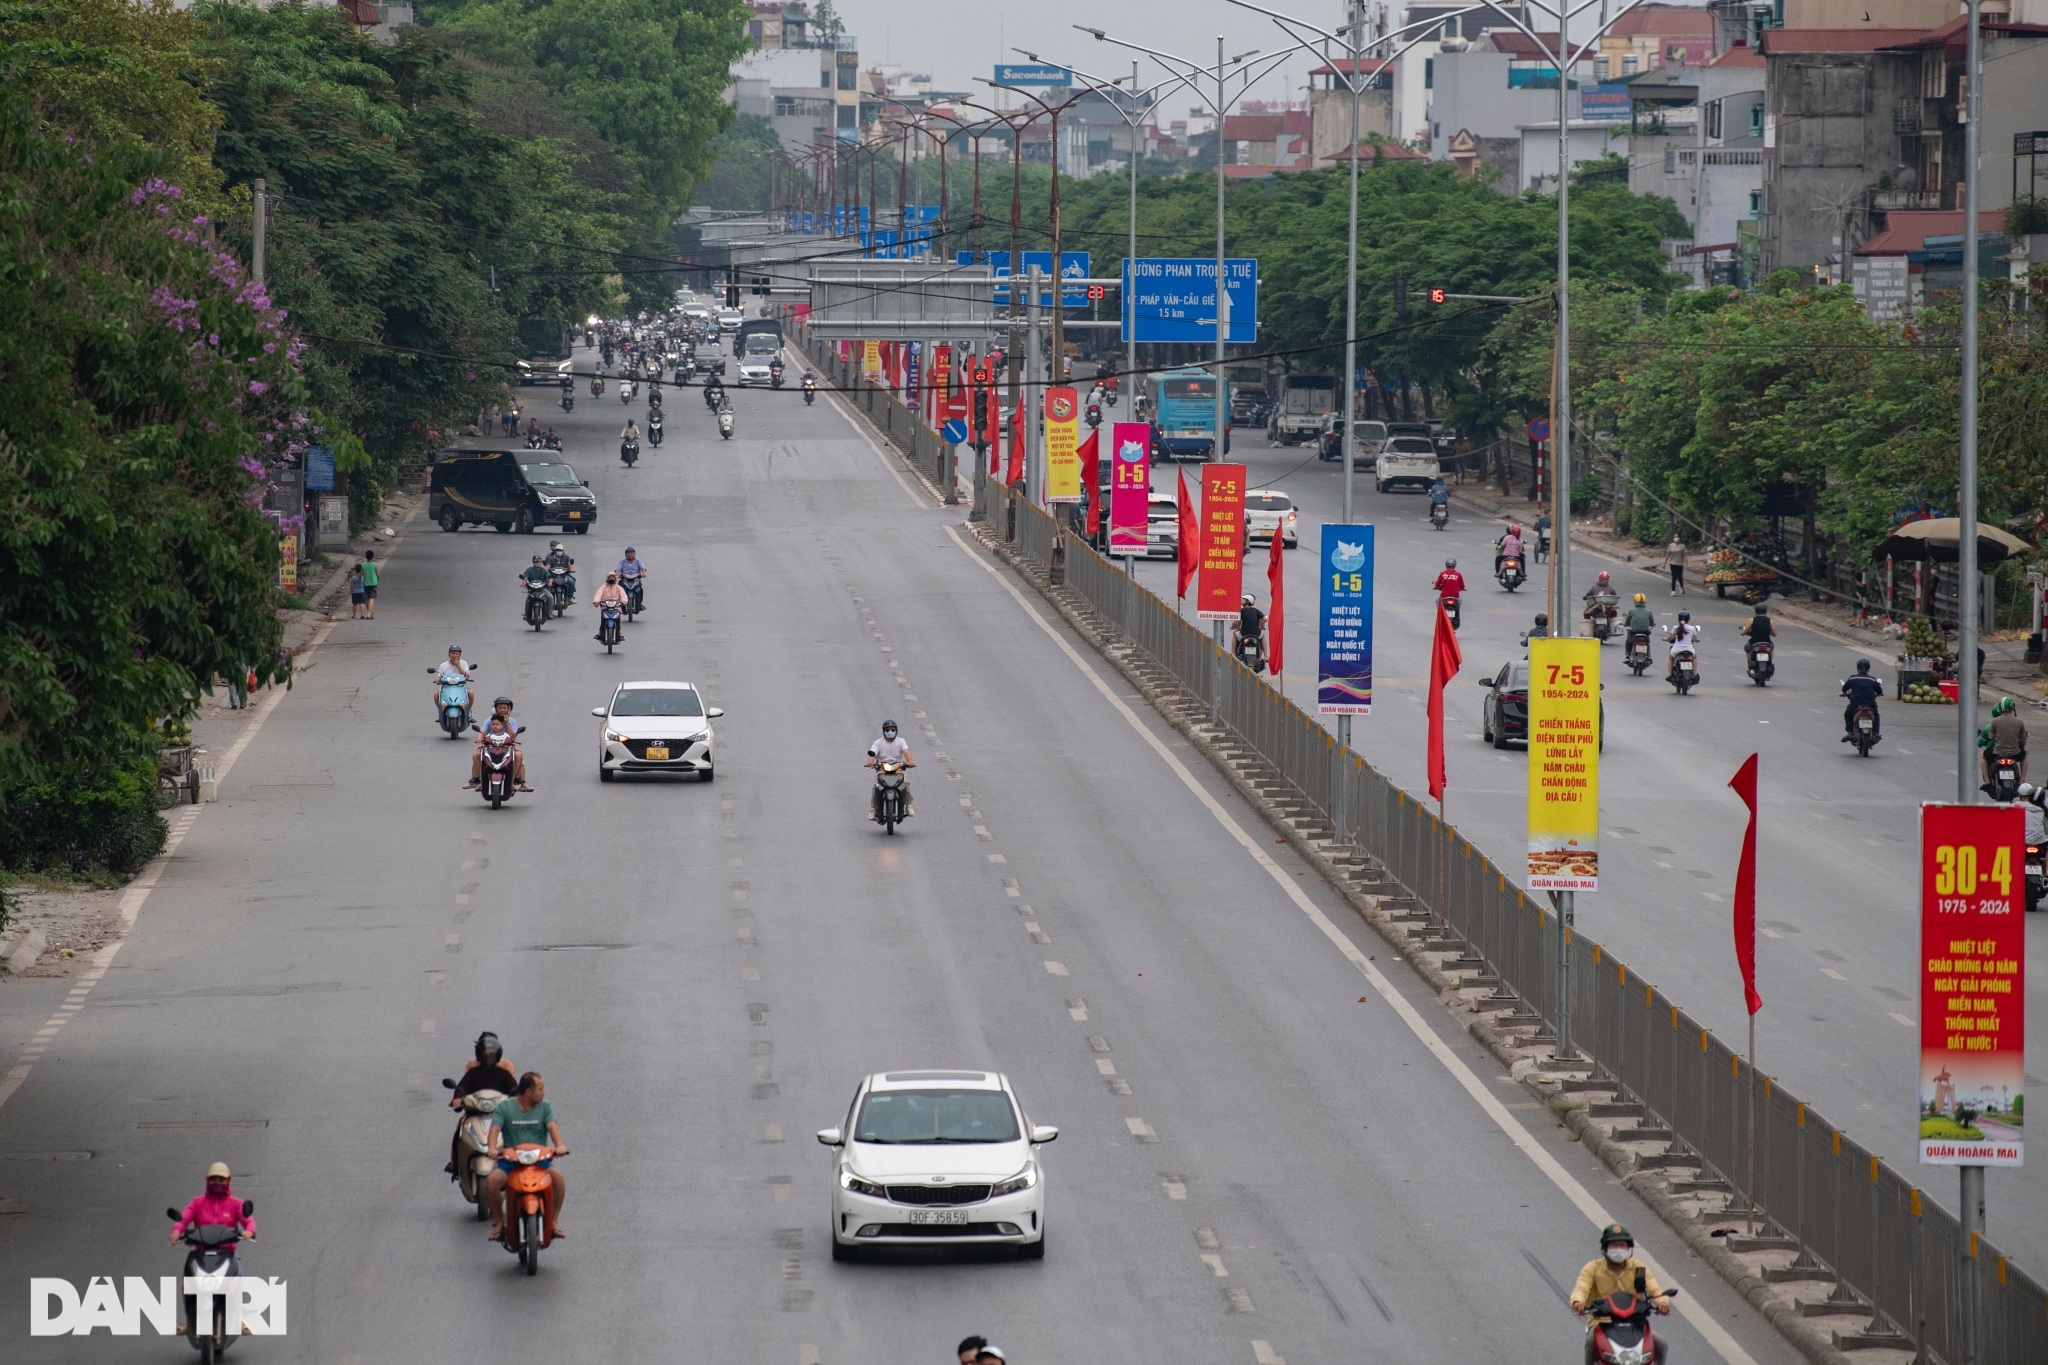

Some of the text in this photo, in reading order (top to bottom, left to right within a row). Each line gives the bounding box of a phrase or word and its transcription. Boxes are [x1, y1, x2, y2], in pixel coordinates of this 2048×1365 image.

[1003, 68, 1065, 80] Sacombank
[1165, 265, 1191, 276] PHAN
[1232, 263, 1251, 279] TUỆ
[1228, 280, 1240, 288] km
[1088, 285, 1104, 299] 23
[1140, 294, 1160, 305] PHÁP
[1172, 309, 1184, 318] km
[1118, 464, 1144, 482] 1-5
[1212, 480, 1236, 494] 7-5
[1332, 573, 1362, 591] 1-5
[1332, 606, 1361, 616] NHIỆT LIỆT
[1330, 617, 1345, 626] CHÀO
[1334, 629, 1357, 638] 138 NĂM
[1326, 639, 1365, 650] NGÀY QUỐC TẾ
[1331, 652, 1342, 661] LAO
[1343, 652, 1357, 662] ĐỘNG
[1546, 665, 1584, 686] 7-5
[1541, 690, 1589, 699] 1954-2024
[1321, 706, 1336, 714] QUẬN
[1338, 706, 1356, 714] HOÀNG
[1540, 717, 1590, 729] CHIẾN THẮNG
[1536, 731, 1593, 745] ĐIỆN BIÊN PHỦ
[1544, 762, 1585, 772] NĂM CHÂU
[1542, 775, 1586, 789] CHẤN ĐỘNG
[1546, 792, 1559, 803] ĐỊA
[1936, 845, 2012, 896] 30-4
[1532, 879, 1594, 889] QUẬN HOÀNG MAI
[1938, 899, 1967, 914] 1975
[1980, 899, 2010, 914] 2024
[1950, 938, 1996, 957] NHIỆT LIỆT
[1929, 958, 1952, 972] CHÀO
[1983, 961, 1994, 973] 49
[1997, 958, 2017, 974] NĂM
[1935, 975, 2011, 992] NGÀY GIẢI PHÓNG
[1974, 998, 1997, 1014] NAM,
[1945, 1013, 2000, 1031] THỐNG NHẤT
[1948, 1032, 1997, 1050] ĐẤT NƯỚC !
[1926, 1145, 2017, 1159] QUẬN HOÀNG MAI
